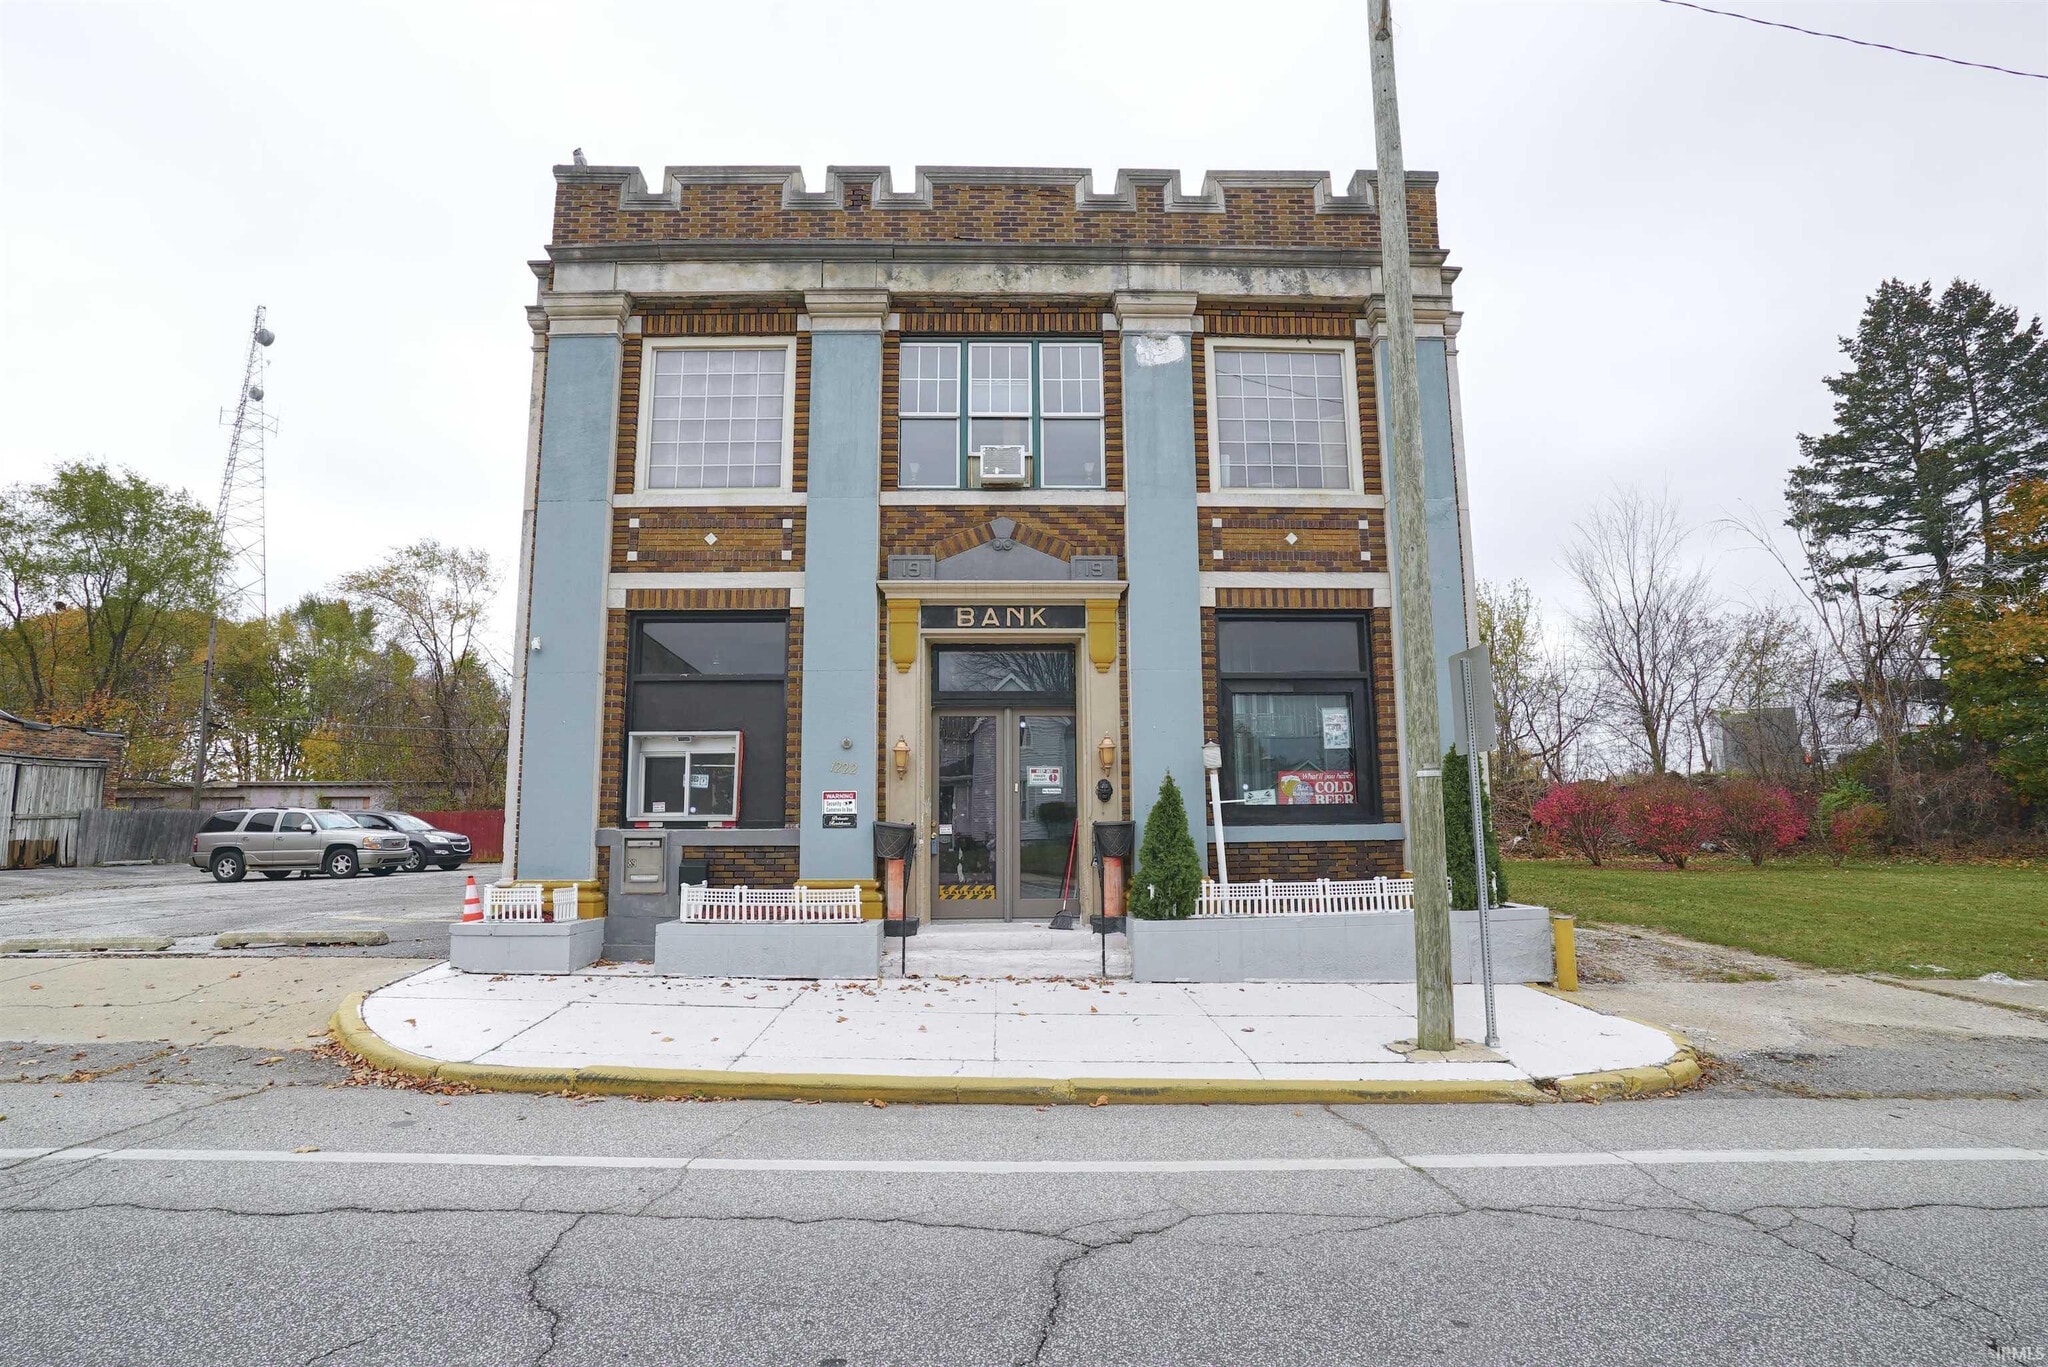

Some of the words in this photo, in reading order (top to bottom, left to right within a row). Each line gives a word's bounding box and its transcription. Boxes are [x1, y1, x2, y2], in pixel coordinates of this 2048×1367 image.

[956, 607, 1047, 628] BANK
[1315, 781, 1354, 793] COLD
[1315, 794, 1354, 804] BEER
